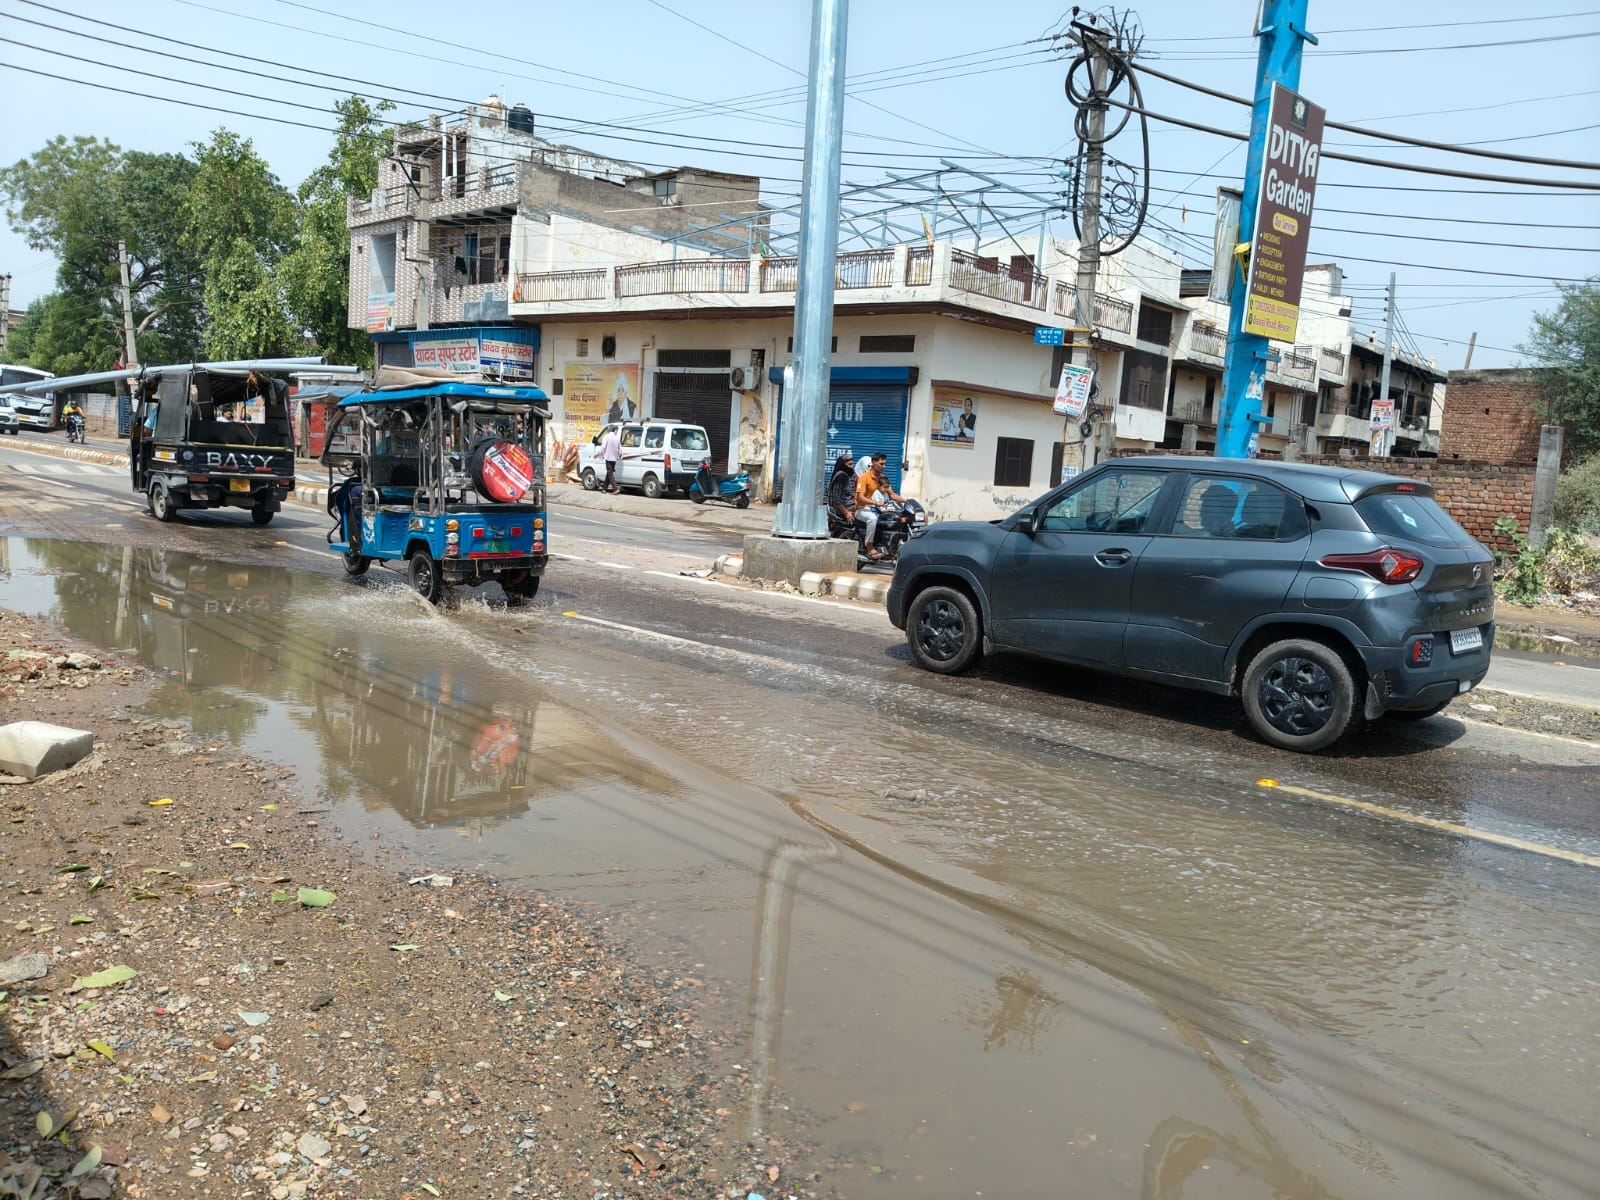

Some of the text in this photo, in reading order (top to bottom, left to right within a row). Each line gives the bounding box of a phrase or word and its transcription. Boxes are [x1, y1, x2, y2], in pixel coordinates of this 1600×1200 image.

[1269, 123, 1319, 178] DITYA
[1266, 167, 1312, 216] Garden
[1263, 231, 1281, 245] WEDDING
[1261, 244, 1283, 258] RECEPTION
[1259, 257, 1286, 272] ENGAGEMENT
[1257, 270, 1276, 283] BIRTHDAY
[415, 348, 436, 363] यादव
[438, 347, 456, 370] सुपर
[458, 343, 478, 361] स्टोर
[482, 343, 532, 358] यादव सुपर स्टोर
[1077, 374, 1090, 384] 22
[206, 451, 274, 468] BAXY
